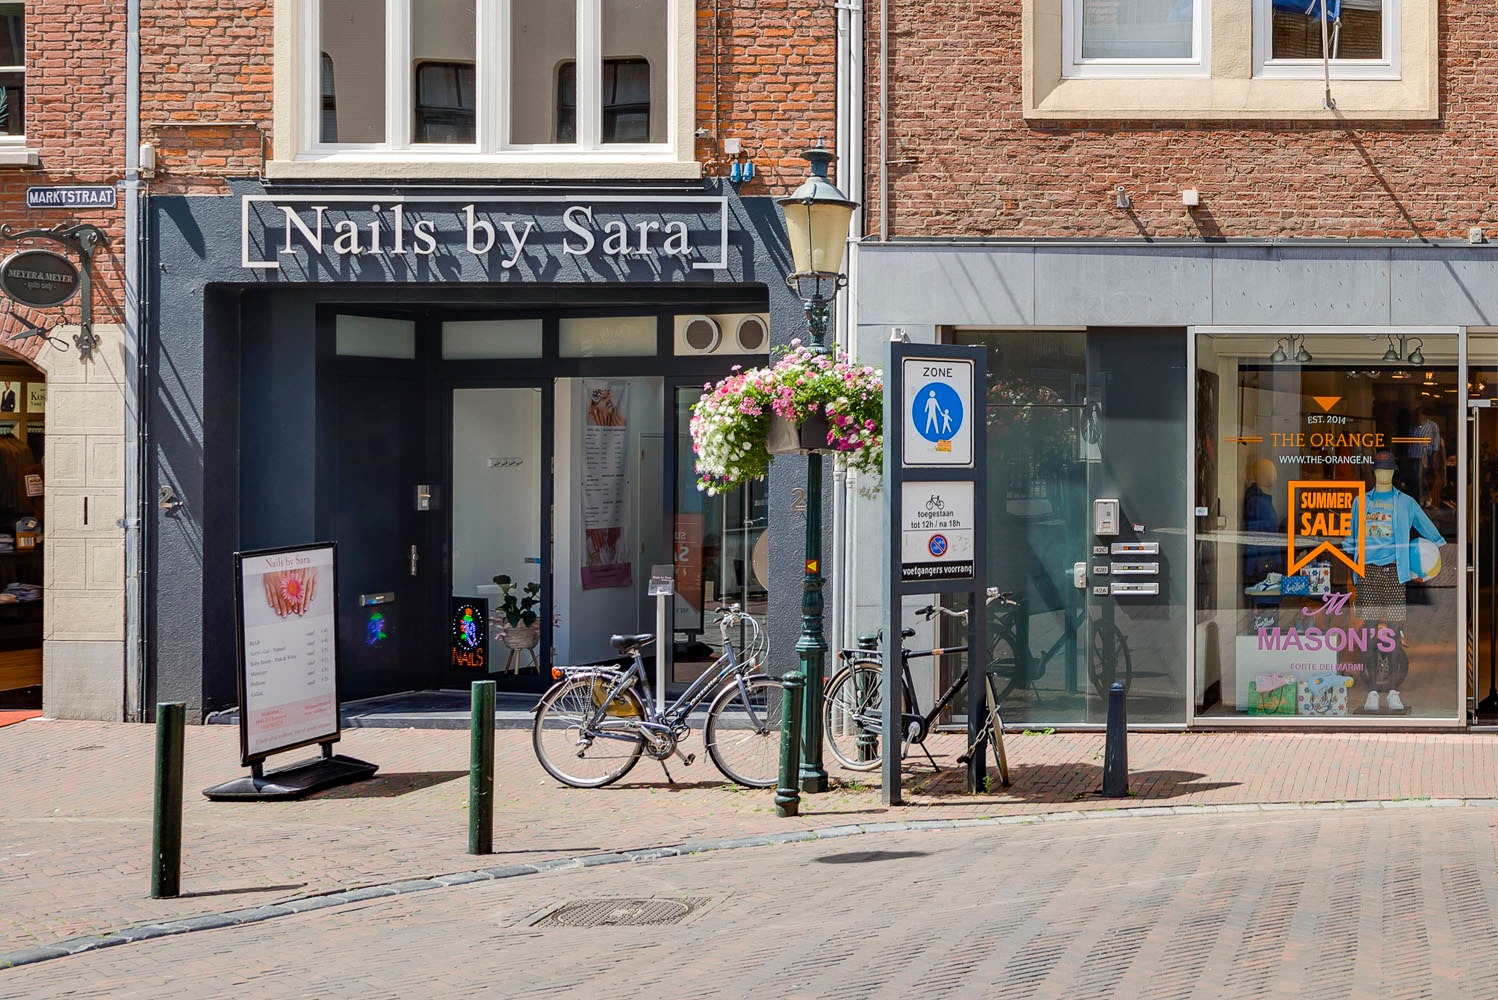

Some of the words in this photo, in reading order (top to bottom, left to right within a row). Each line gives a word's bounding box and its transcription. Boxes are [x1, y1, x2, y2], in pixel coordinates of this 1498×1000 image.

[29, 191, 113, 204] MARKTSTRAAT
[279, 205, 437, 256] Nails
[462, 205, 534, 269] by
[562, 205, 694, 256] Sara
[923, 367, 953, 378] ZONE
[1307, 416, 1325, 424] EST.
[1327, 416, 1346, 425] 2014
[1270, 433, 1305, 447] THE
[1310, 433, 1385, 448] ORANGE
[1279, 455, 1375, 464] WWW.THE-ORANGE.NL
[159, 485, 174, 508] 2
[790, 487, 806, 511] 2
[1301, 492, 1353, 509] SUMMER
[918, 510, 954, 519] toegestaan
[911, 521, 921, 529] tot
[922, 520, 934, 529] 12h
[949, 519, 961, 528] 18h
[1301, 512, 1353, 537] SALE
[265, 558, 284, 569] Nails
[285, 557, 294, 569] by
[295, 554, 311, 565] Sara
[903, 566, 943, 577] voetgangers
[944, 564, 973, 575] voorrang
[452, 647, 484, 667] NAILS
[1319, 663, 1333, 671] DEI
[1336, 663, 1364, 672] MARMI
